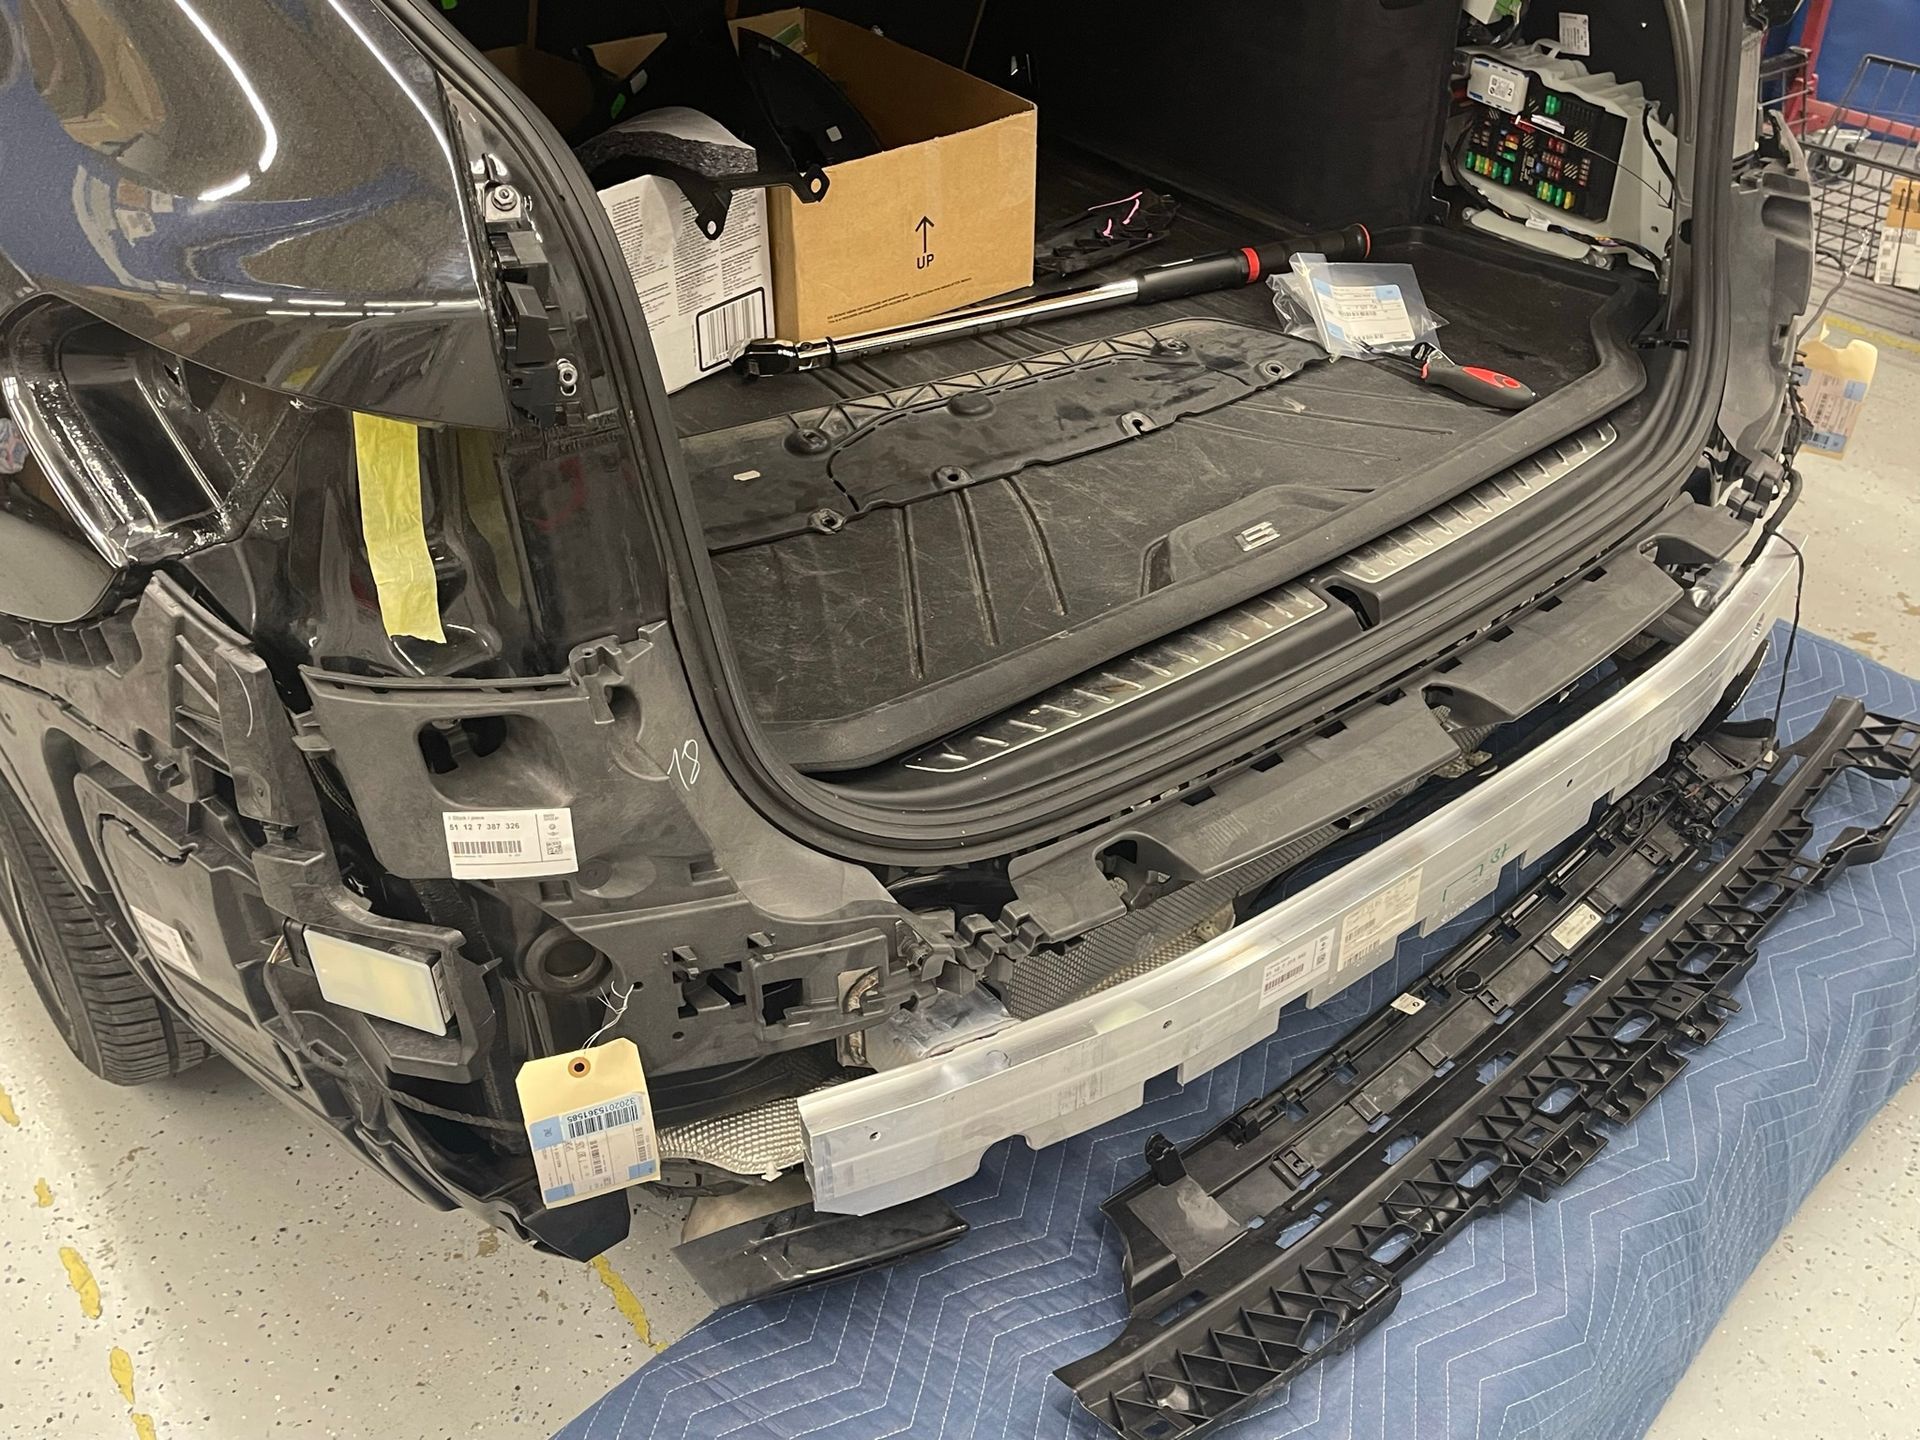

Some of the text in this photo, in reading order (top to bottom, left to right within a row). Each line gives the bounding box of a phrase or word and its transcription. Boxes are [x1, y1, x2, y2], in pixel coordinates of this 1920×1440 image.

[916, 253, 935, 270] UP
[667, 738, 701, 791] 18
[449, 823, 459, 831] 51
[505, 822, 520, 830] 326
[566, 1097, 636, 1122] 3202015361585
